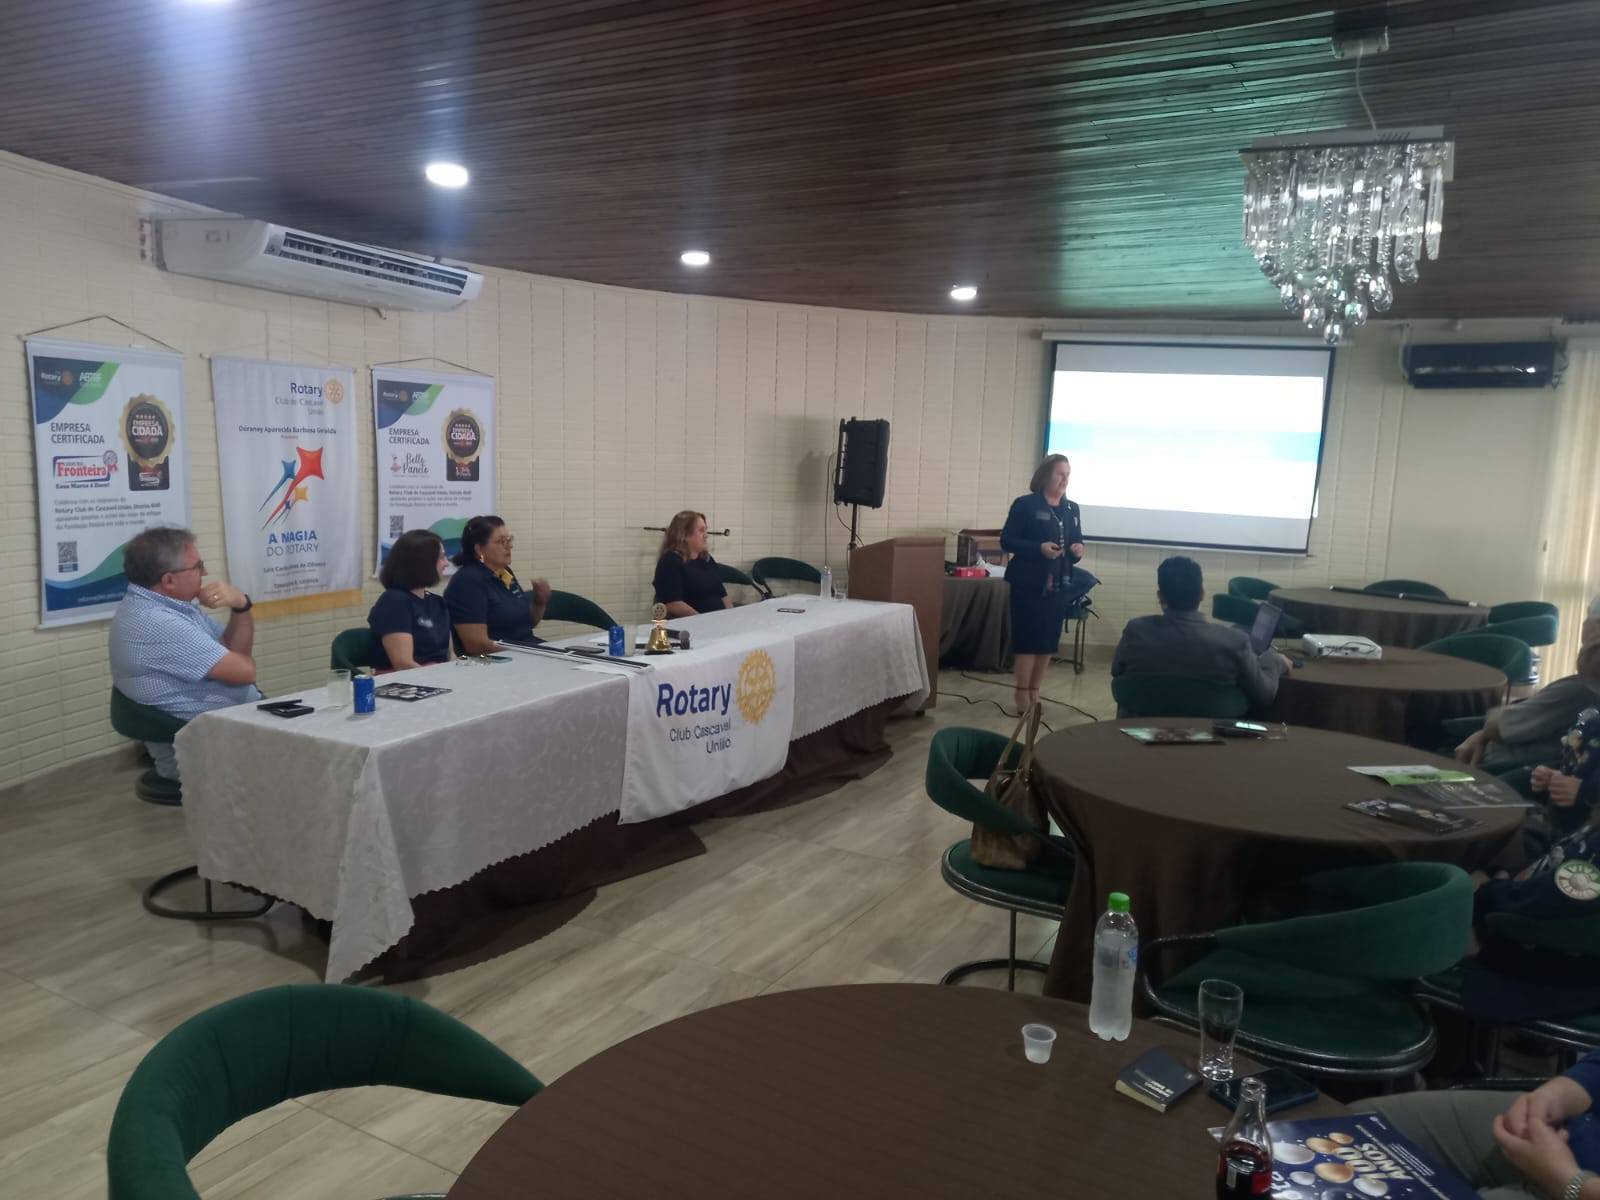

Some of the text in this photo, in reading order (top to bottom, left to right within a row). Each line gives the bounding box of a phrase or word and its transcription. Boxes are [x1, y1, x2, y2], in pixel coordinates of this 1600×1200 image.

[290, 382, 323, 397] Rotary
[51, 422, 91, 433] EMPRESA
[389, 428, 419, 436] EMPRESA
[51, 434, 105, 445] CERTIFICADA
[389, 436, 430, 445] CERTIFICADA
[56, 462, 107, 477] Fronteira
[268, 533, 278, 545] A
[266, 545, 284, 557] DO
[656, 683, 732, 718] Rotary
[669, 726, 691, 742] Club
